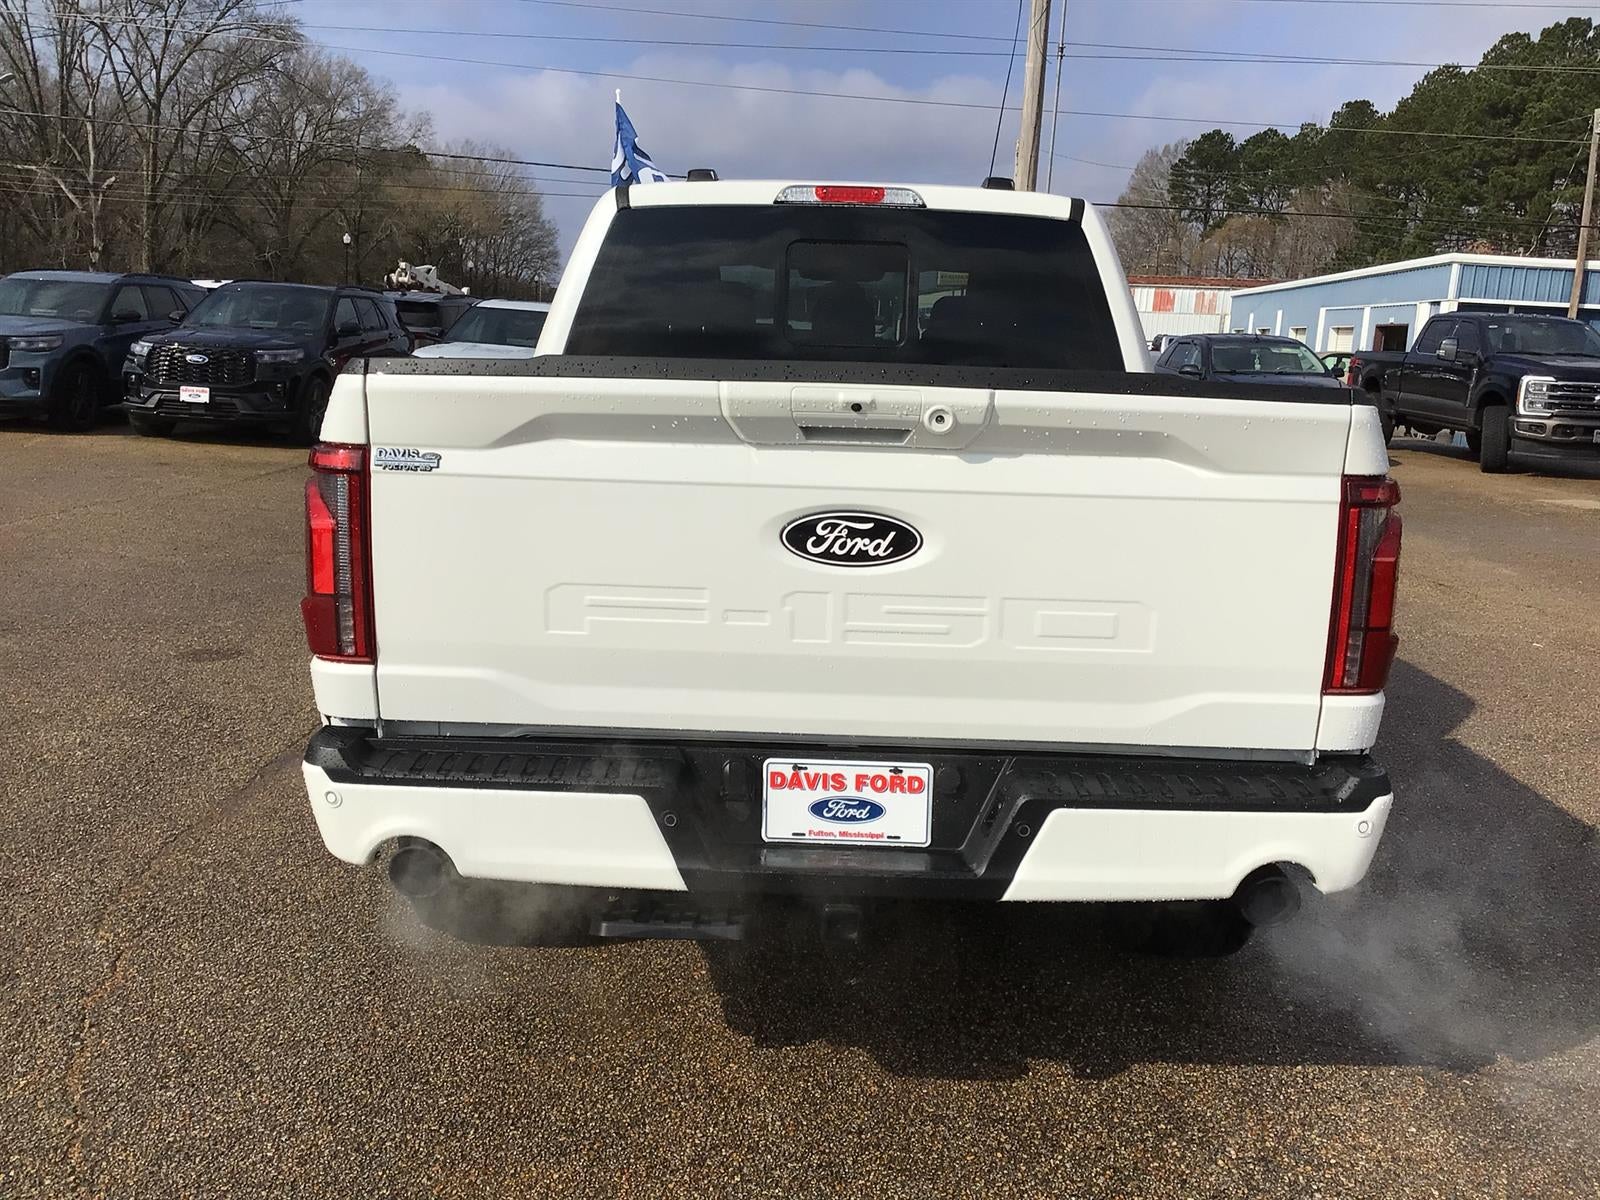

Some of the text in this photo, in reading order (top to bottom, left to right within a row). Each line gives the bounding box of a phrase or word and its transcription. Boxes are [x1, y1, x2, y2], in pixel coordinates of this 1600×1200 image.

[376, 447, 420, 459] DAVIS
[806, 519, 896, 557] Ford
[544, 582, 1156, 654] F-150
[769, 771, 926, 795] DAVIS FORD
[822, 799, 872, 819] Ford
[808, 829, 884, 839] Fulton, Mississippi
